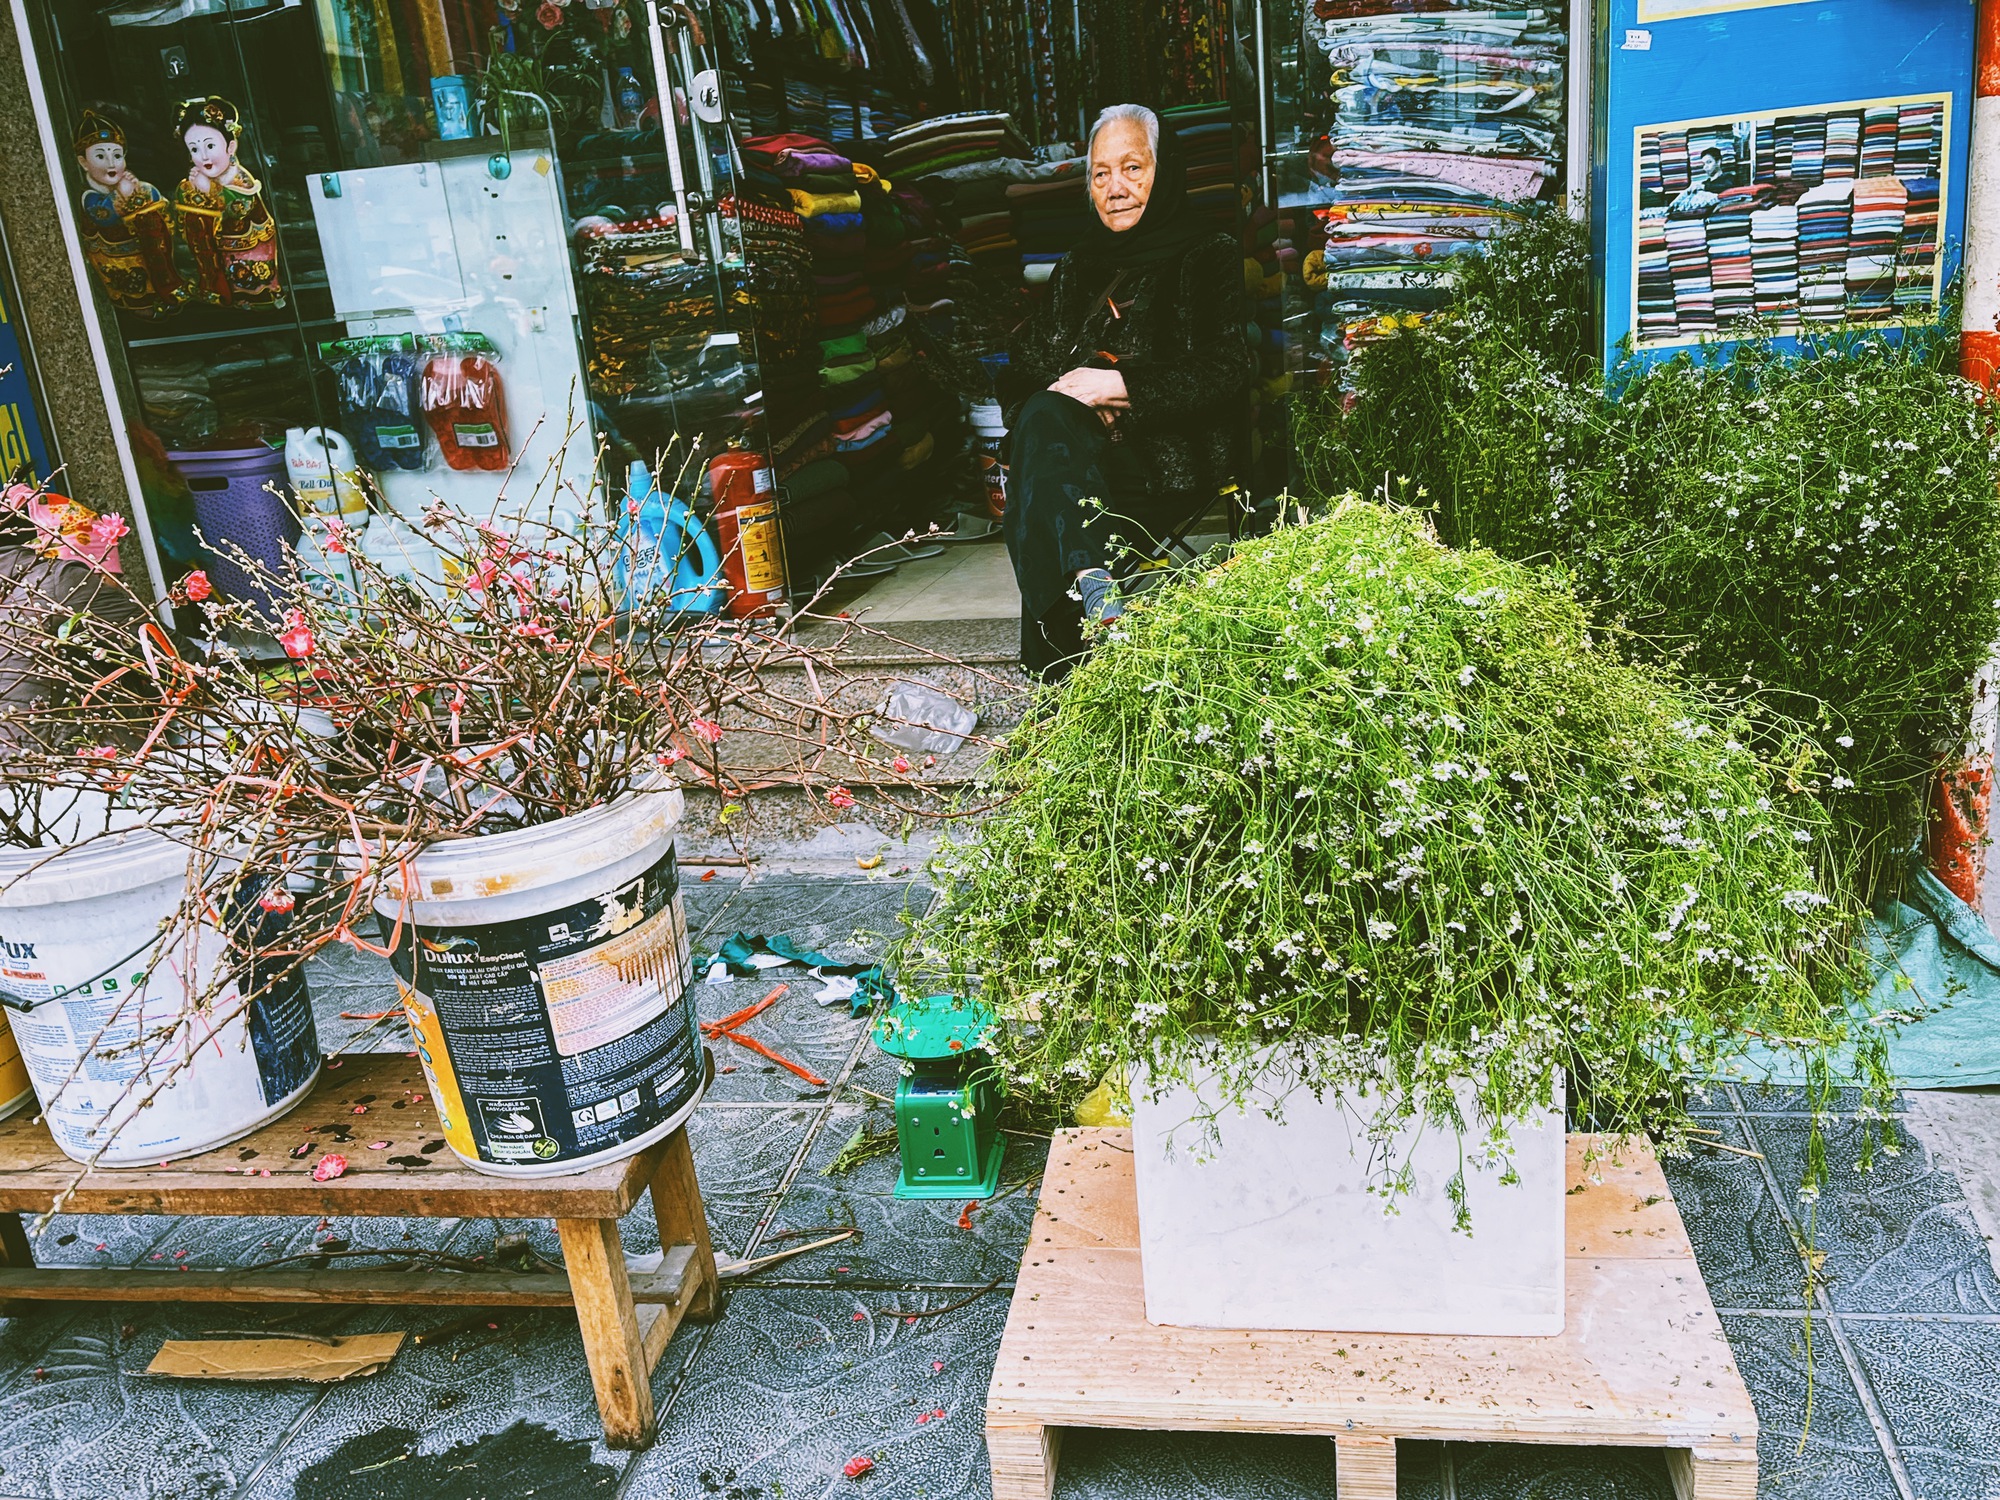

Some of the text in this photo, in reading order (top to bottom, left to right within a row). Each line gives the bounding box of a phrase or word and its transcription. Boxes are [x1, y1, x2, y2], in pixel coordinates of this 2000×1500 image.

[298, 480, 315, 489] Bell
[423, 949, 474, 964] Dulux
[479, 951, 525, 964] EasyClean
